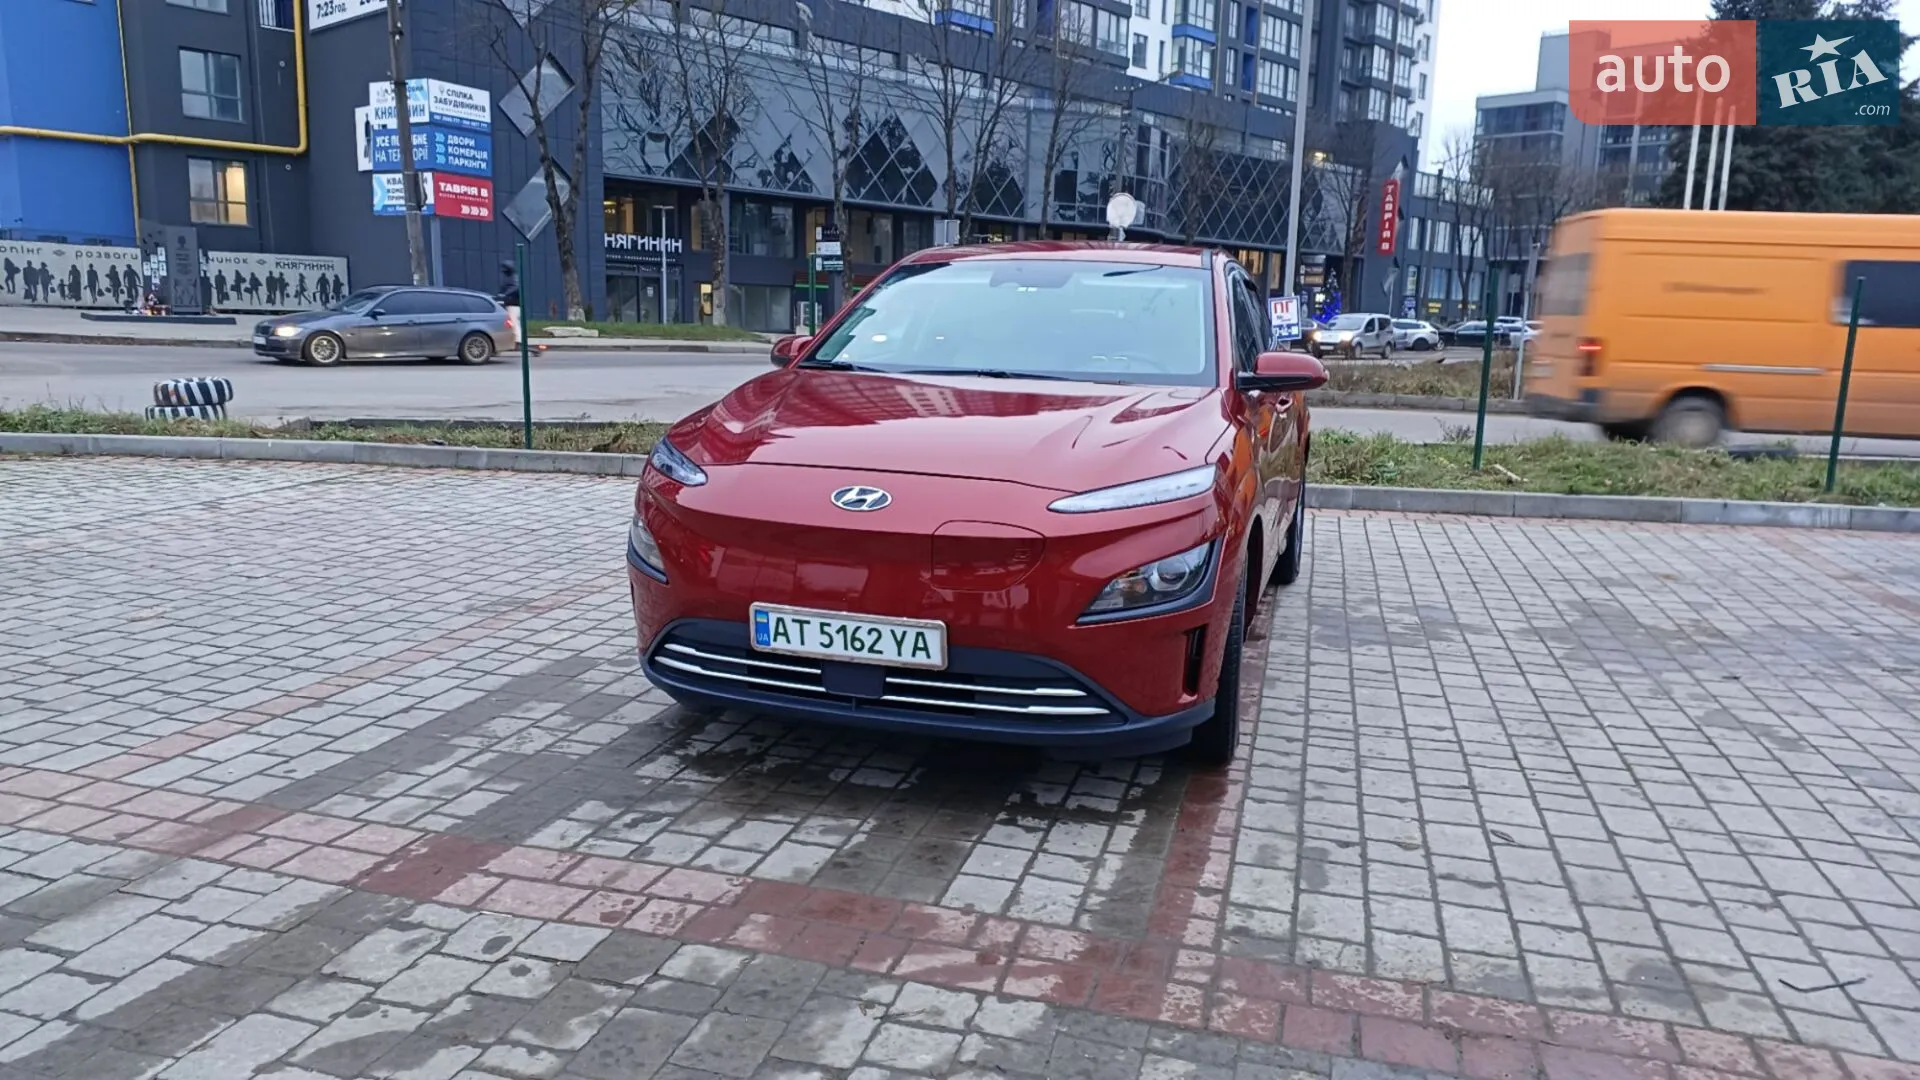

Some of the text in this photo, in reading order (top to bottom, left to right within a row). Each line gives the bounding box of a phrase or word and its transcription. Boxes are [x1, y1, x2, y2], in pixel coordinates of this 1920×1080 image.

[446, 88, 474, 101] СПІЛКА
[433, 95, 487, 113] ЗАБУДІВНИКІВ
[375, 135, 390, 147] УСЕ
[447, 134, 476, 148] ДВОРИ
[375, 148, 387, 162] НА
[447, 145, 489, 161] КОМЕРЦІЯ
[448, 155, 487, 170] ПАРКІНГИ
[438, 181, 489, 197] ТАВРІЯ В
[757, 634, 769, 642] UA
[772, 616, 932, 659] AT 5162 YA
